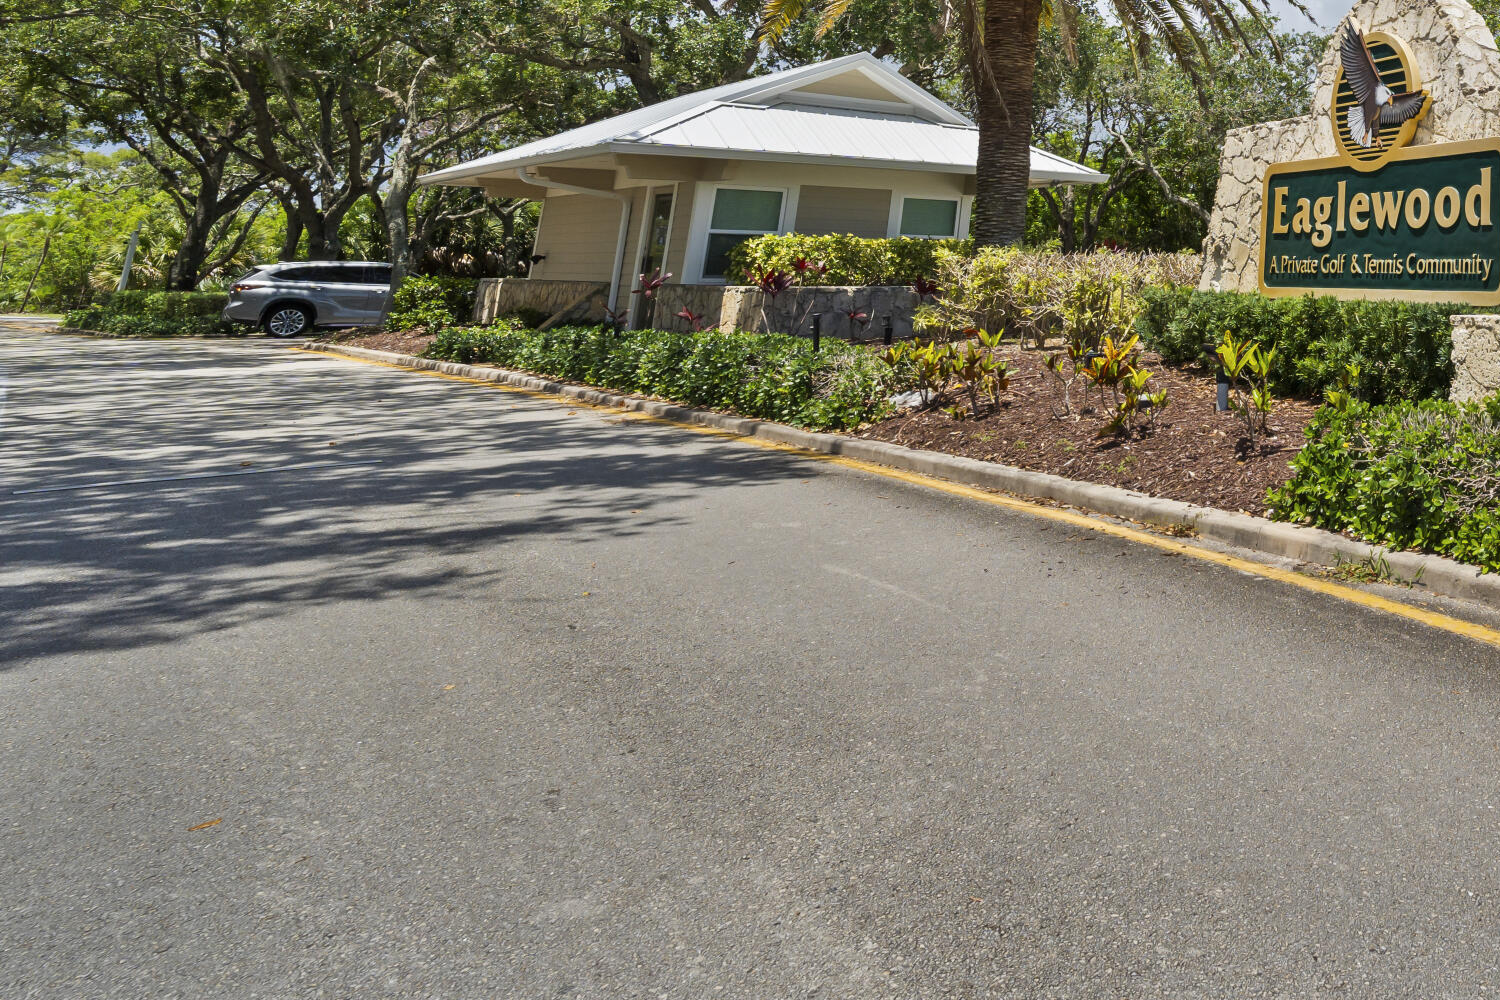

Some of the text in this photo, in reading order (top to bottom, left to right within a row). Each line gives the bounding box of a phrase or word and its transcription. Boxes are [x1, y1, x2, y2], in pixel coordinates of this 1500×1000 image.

[1272, 167, 1493, 247] Eaglewood
[1269, 253, 1493, 281] A Private Golf & Tennis Community
